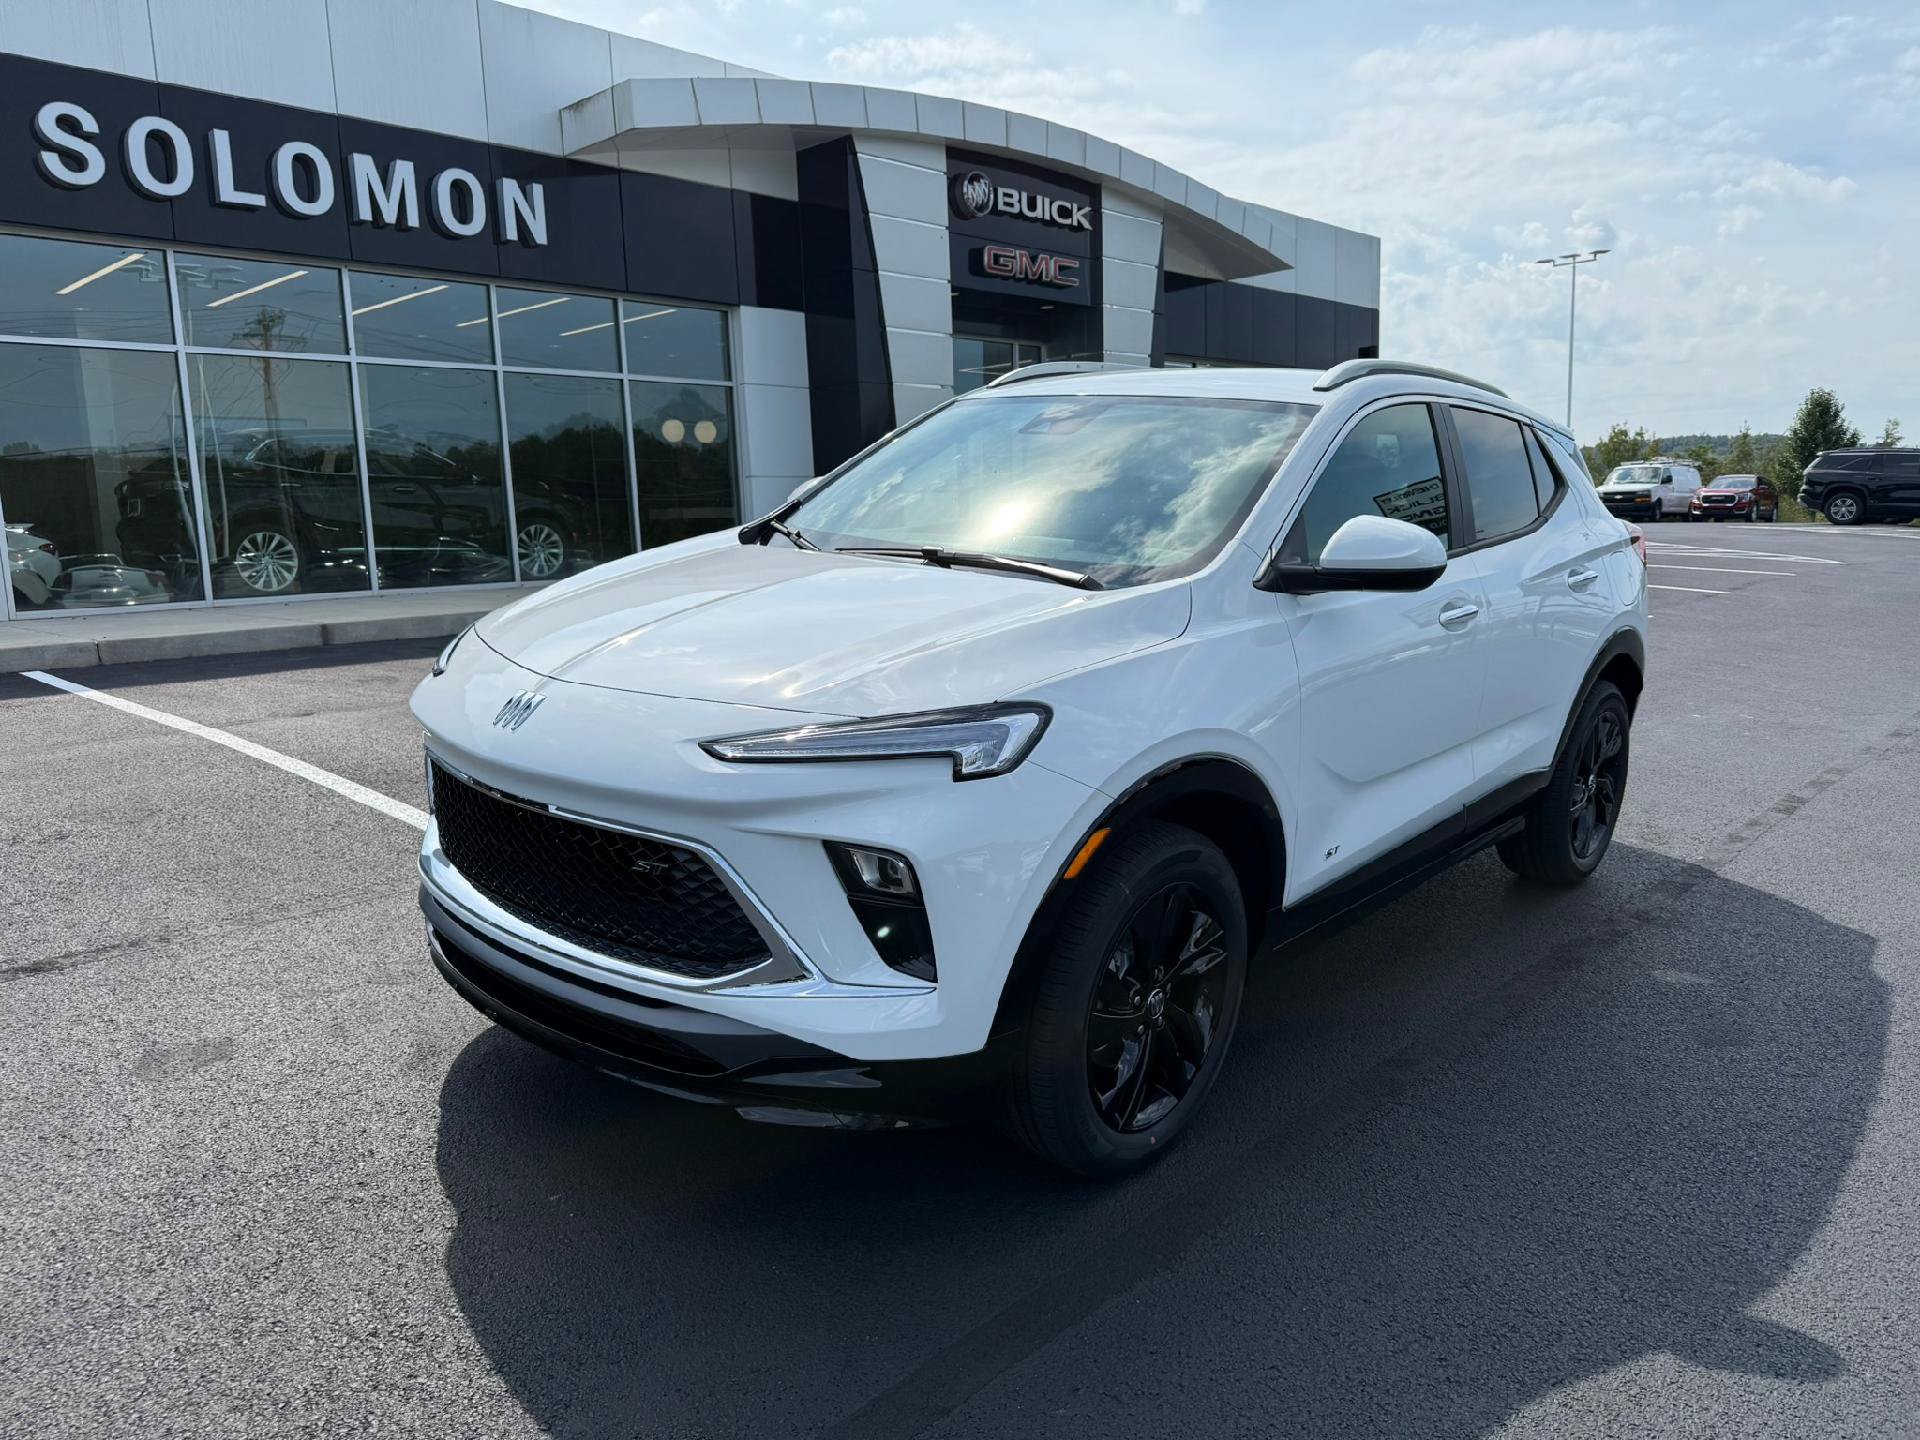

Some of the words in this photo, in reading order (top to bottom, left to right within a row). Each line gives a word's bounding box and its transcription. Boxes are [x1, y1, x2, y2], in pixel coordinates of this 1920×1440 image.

[33, 100, 549, 247] SOLOMON
[997, 187, 1093, 230] BUICK
[983, 245, 1080, 287] GMC
[631, 859, 669, 875] ST
